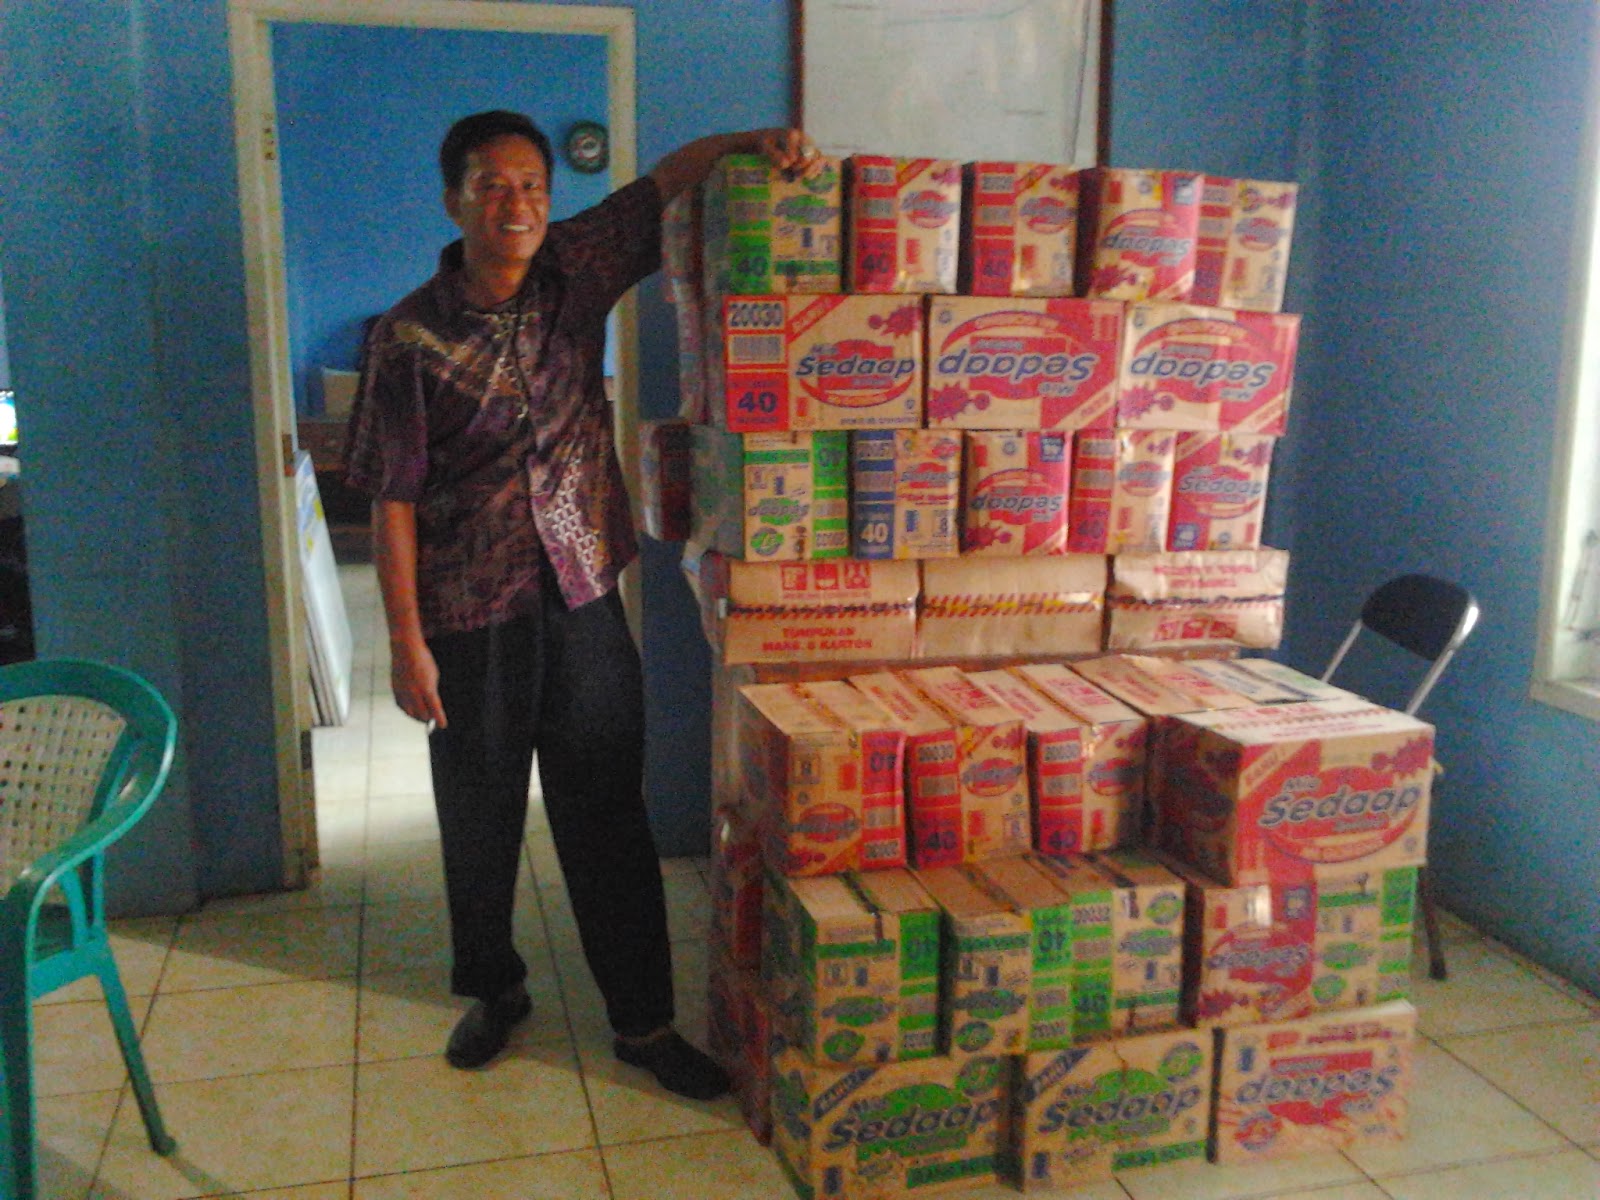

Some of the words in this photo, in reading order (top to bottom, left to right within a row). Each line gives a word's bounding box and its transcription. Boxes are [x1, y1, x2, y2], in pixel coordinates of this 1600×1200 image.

[796, 354, 916, 379] Sedaap
[938, 349, 1099, 382] Sedaap
[1130, 351, 1277, 387] Sedaap
[737, 391, 778, 412] 40
[1039, 382, 1077, 396] Mie
[1179, 475, 1264, 496] Sedaap
[970, 492, 1064, 513] Sedaap
[860, 522, 888, 544] 40
[1259, 784, 1422, 827] Sedaap
[1236, 1064, 1401, 1105] Sedaap
[1037, 1085, 1201, 1133] Sedaap
[822, 1098, 1004, 1152] Sedaap
